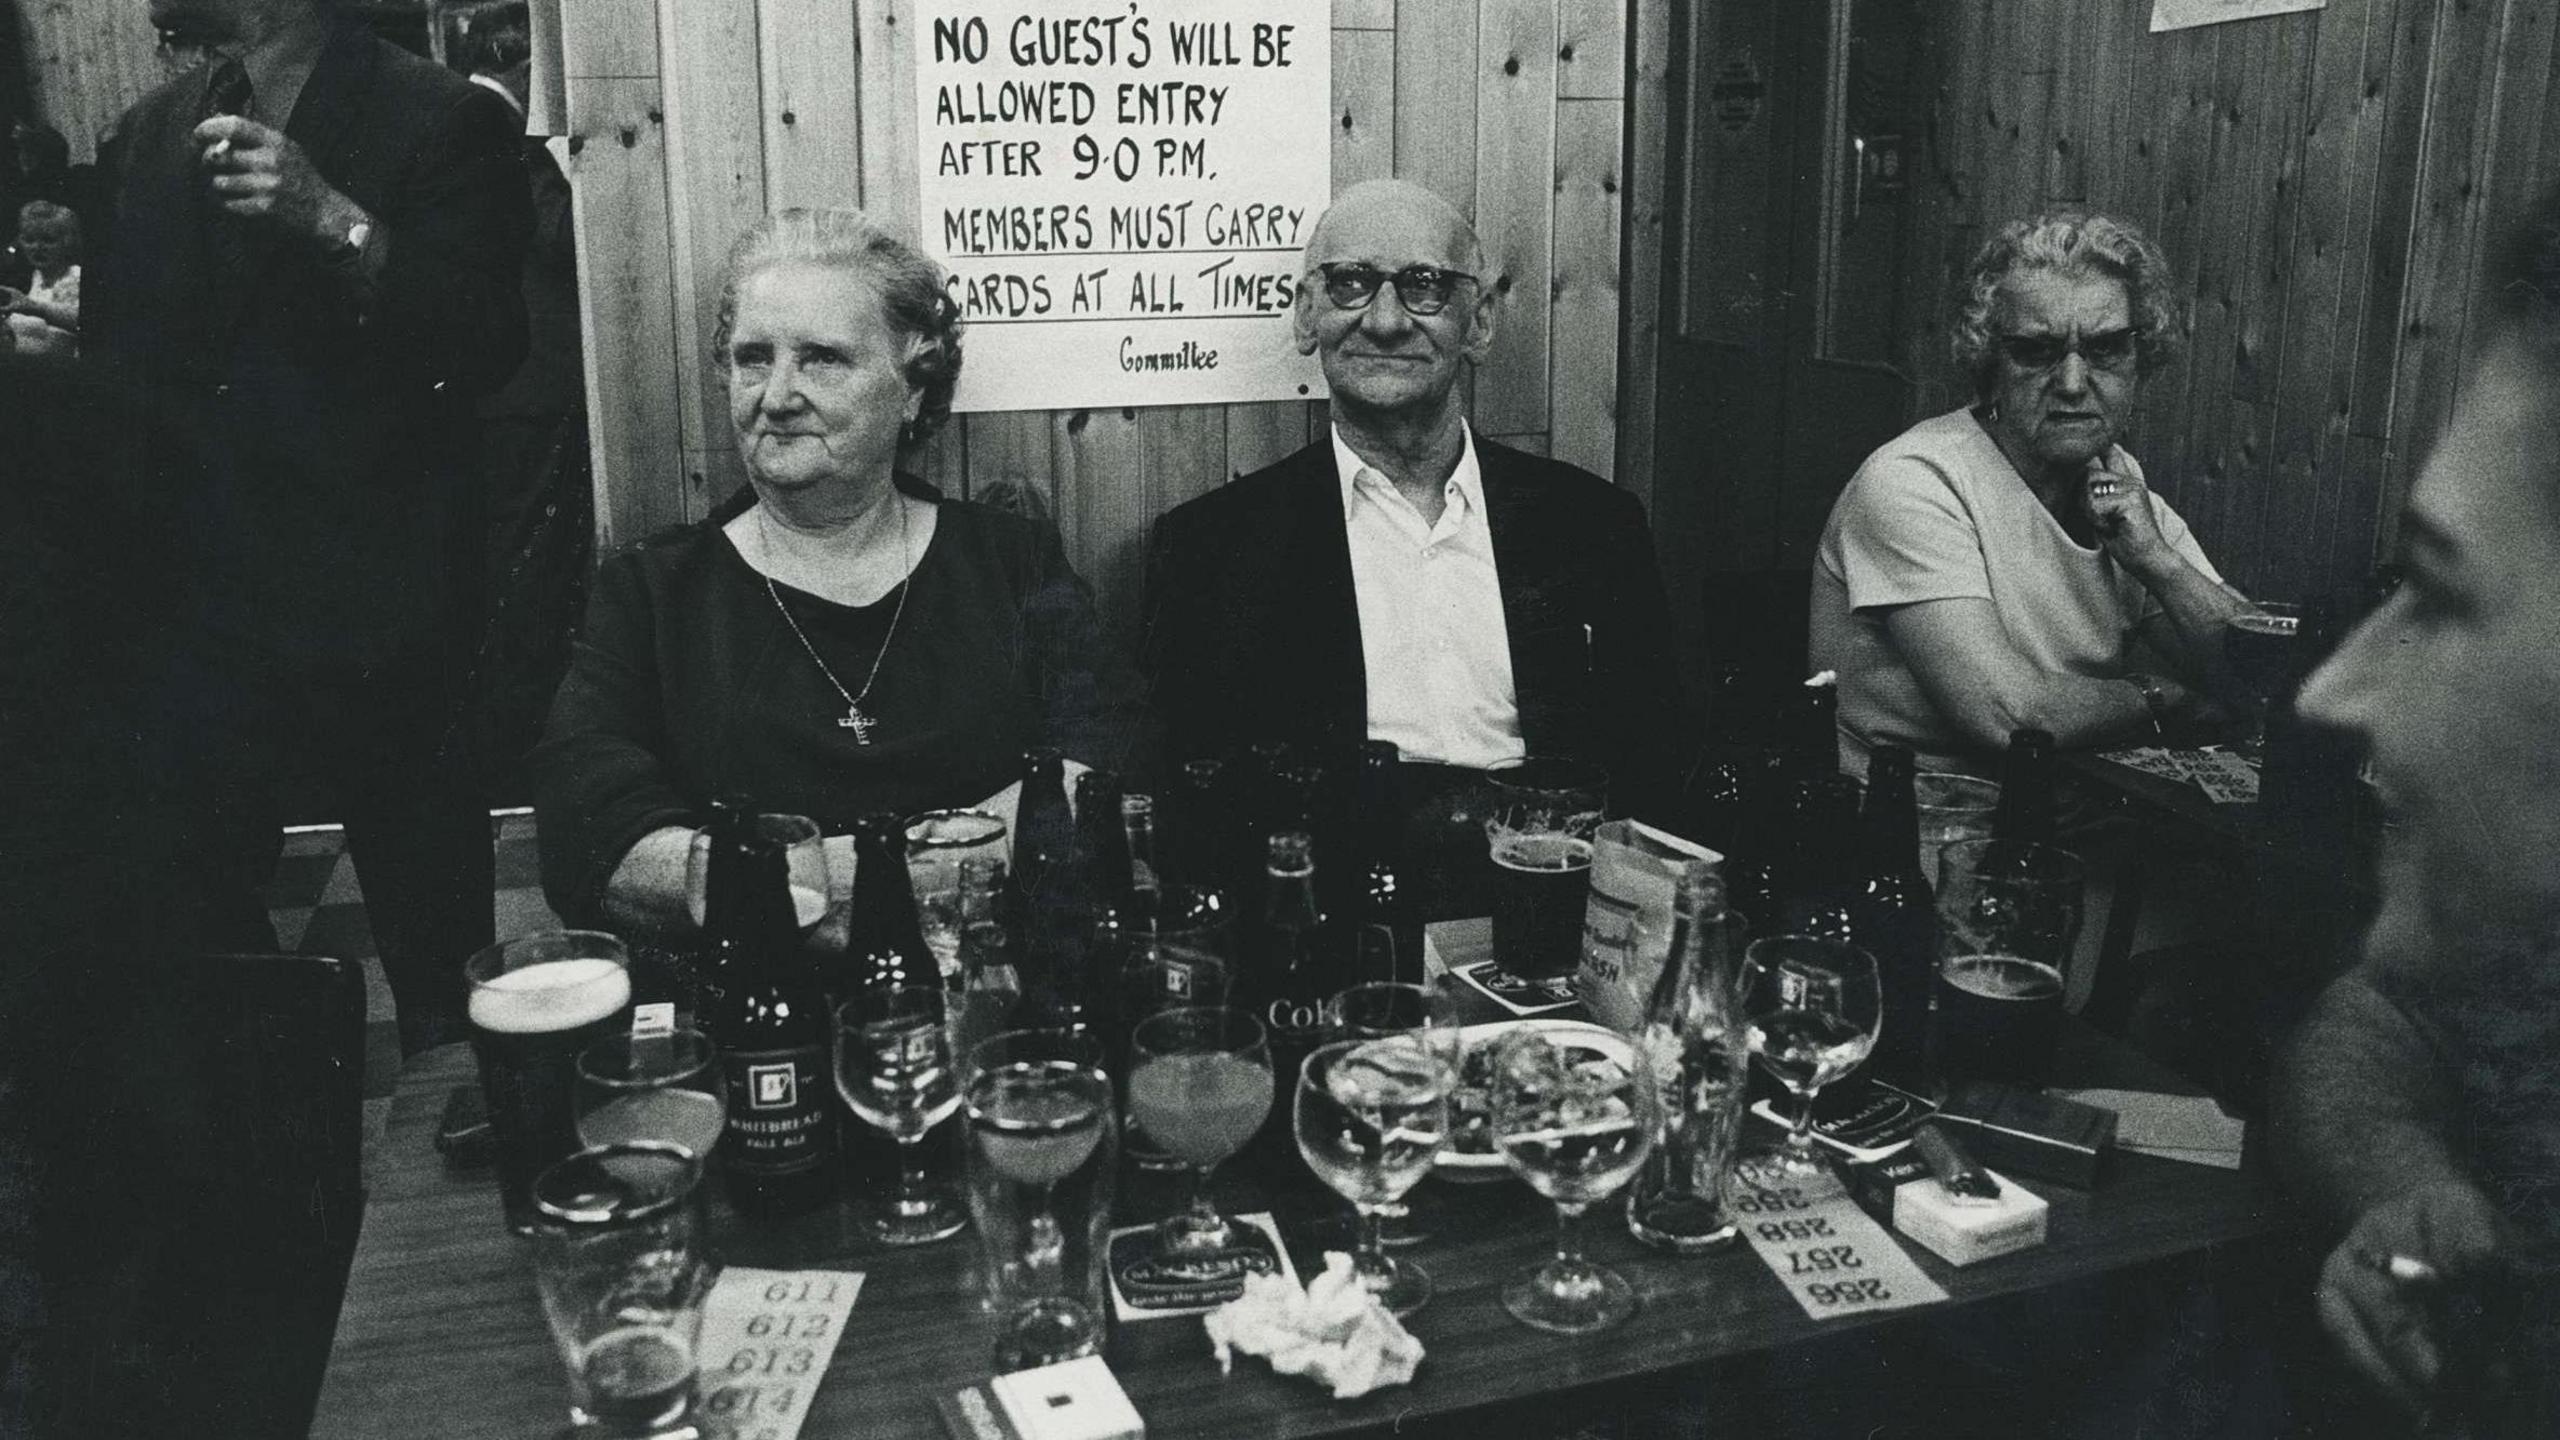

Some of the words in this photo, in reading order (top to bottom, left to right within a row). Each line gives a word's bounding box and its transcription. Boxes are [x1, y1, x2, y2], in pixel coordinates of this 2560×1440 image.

[934, 16, 989, 65] NO
[1009, 2, 1152, 68] GUEST'S
[1169, 21, 1241, 67] WILL
[1252, 22, 1296, 67] BE
[936, 80, 1096, 126] ALLOWED
[1117, 81, 1230, 126] ENTRY
[939, 139, 1042, 177] AFTER
[1153, 137, 1218, 181] P.M.
[943, 204, 1093, 254] MEMBERS
[1110, 200, 1194, 252] MUST
[1205, 202, 1306, 247] CARRY
[1072, 268, 1109, 314] AT
[1130, 270, 1185, 313] ALL
[1198, 257, 1295, 313] TIMES
[1119, 335, 1219, 373] Committee
[1756, 1217, 1837, 1242] 258
[1786, 1245, 1863, 1275] 257
[764, 1279, 839, 1303] 611
[1806, 1277, 1892, 1307] 256
[747, 1313, 832, 1338] 612
[726, 1347, 815, 1376] 613
